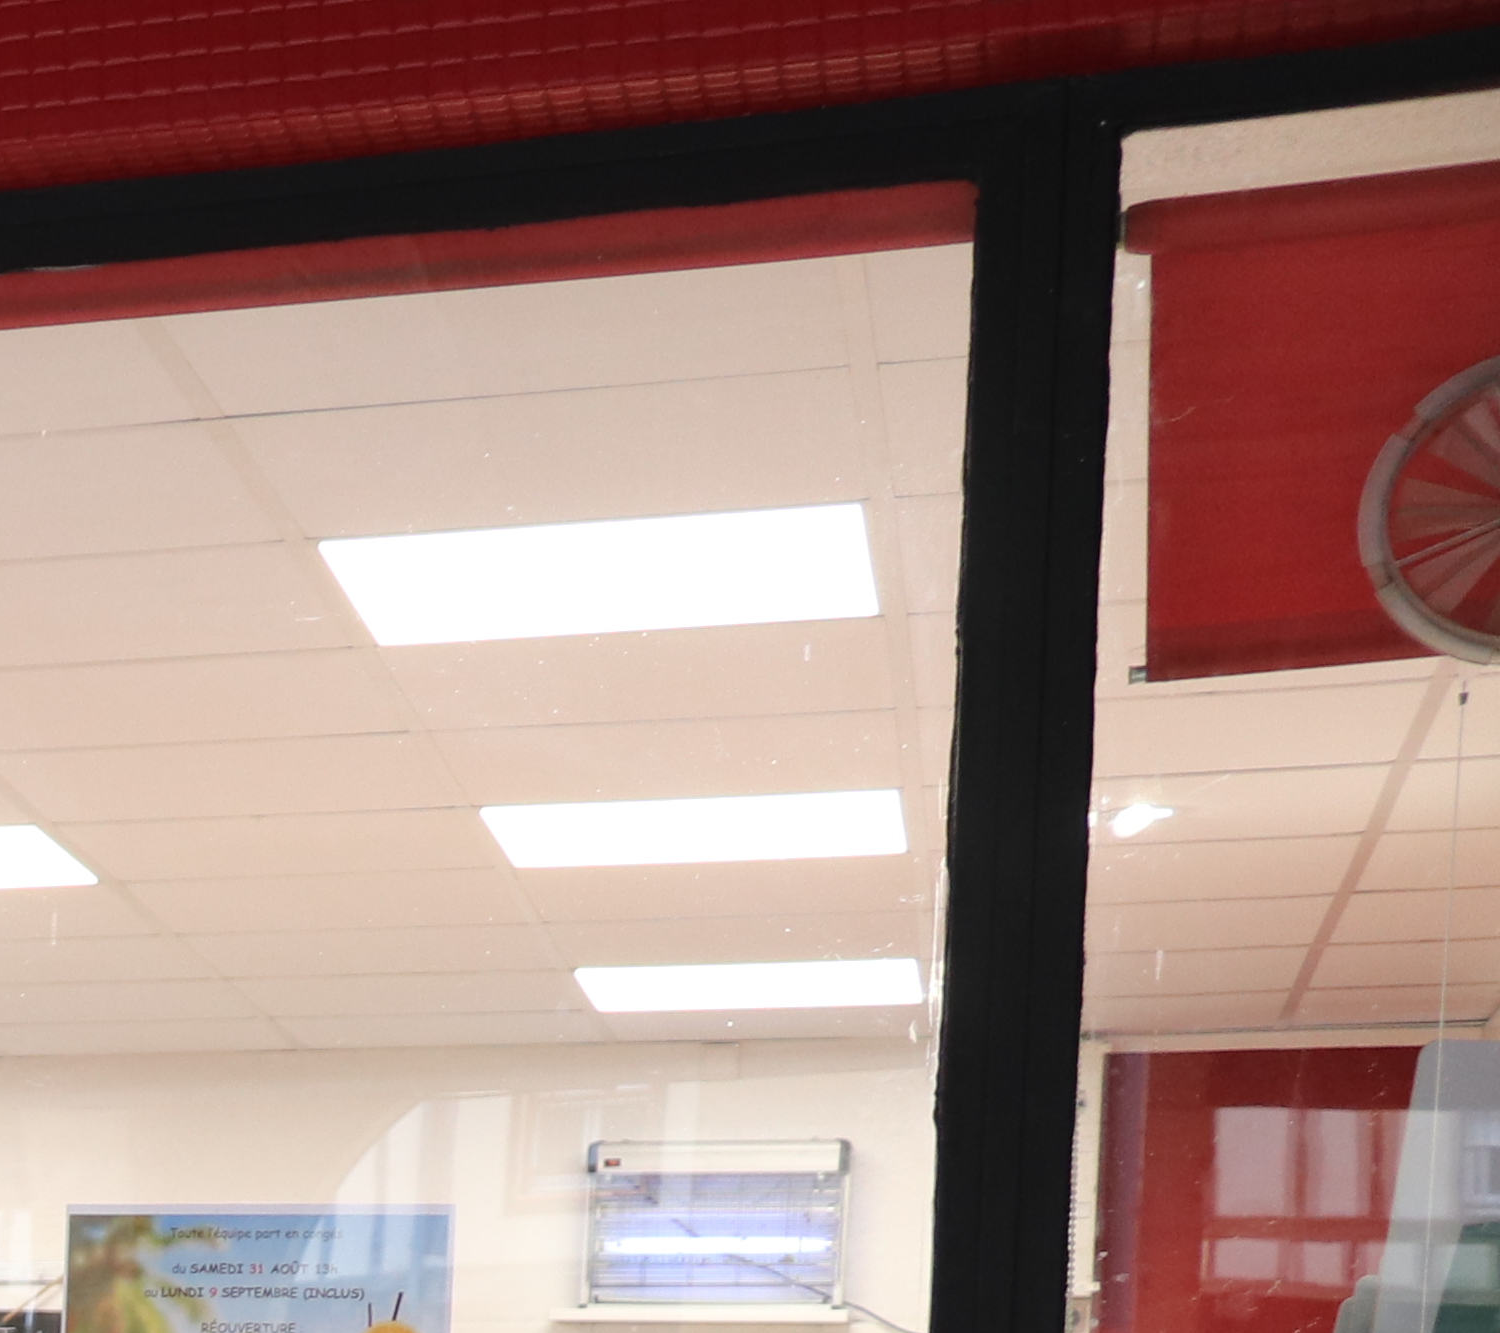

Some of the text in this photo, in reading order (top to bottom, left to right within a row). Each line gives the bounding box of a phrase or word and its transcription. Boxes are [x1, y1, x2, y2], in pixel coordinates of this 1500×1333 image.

[170, 1225, 344, 1242] Toute l'équipe part en congés
[171, 1259, 338, 1275] du SAMEDI 31 AOÛT 13h
[144, 1286, 366, 1301] au LUNDI 9 SEPTEMBRE (INCLUS)
